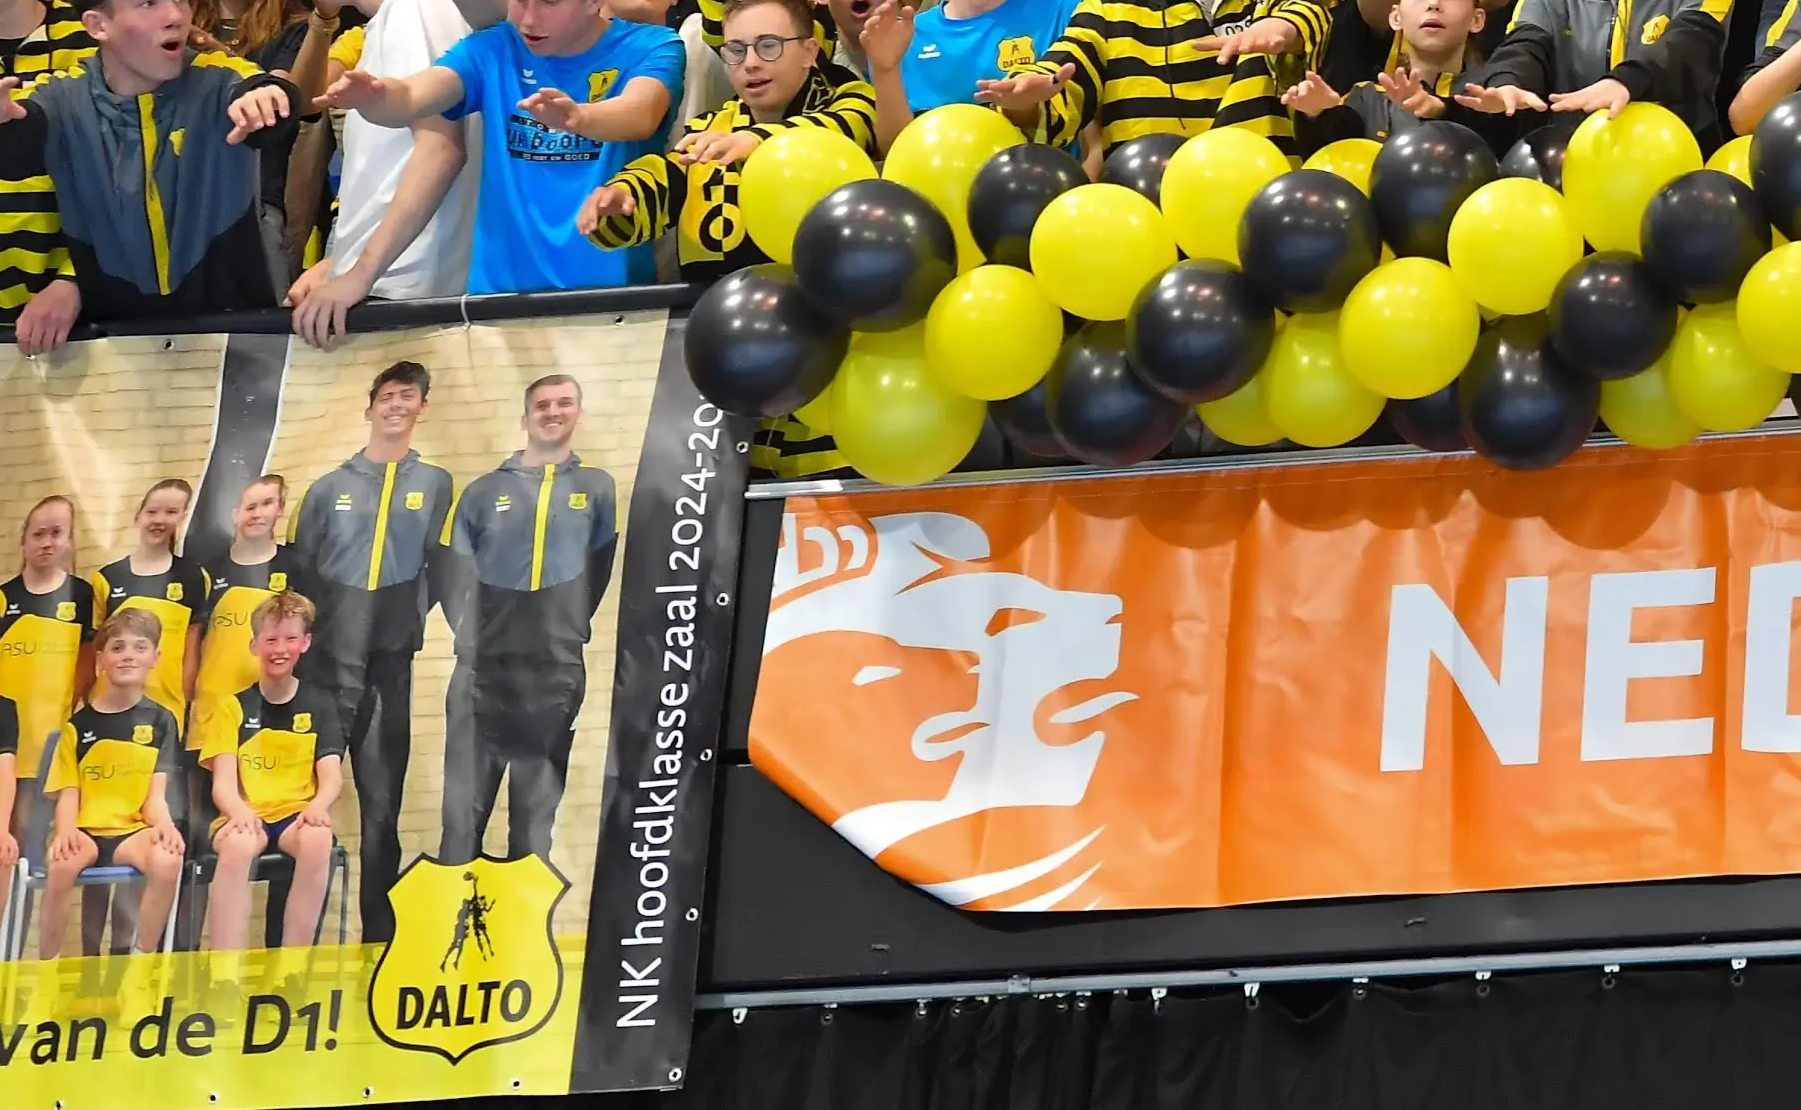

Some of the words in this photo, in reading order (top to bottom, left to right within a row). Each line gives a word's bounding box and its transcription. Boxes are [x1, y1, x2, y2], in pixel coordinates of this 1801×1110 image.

[669, 395, 724, 571] 2024-20
[655, 585, 699, 673] zaal
[621, 682, 689, 946] hoofdklasse
[131, 997, 216, 1056] de
[242, 989, 342, 1053] D1!
[396, 978, 533, 1030] DALTO
[616, 957, 662, 1028] NK
